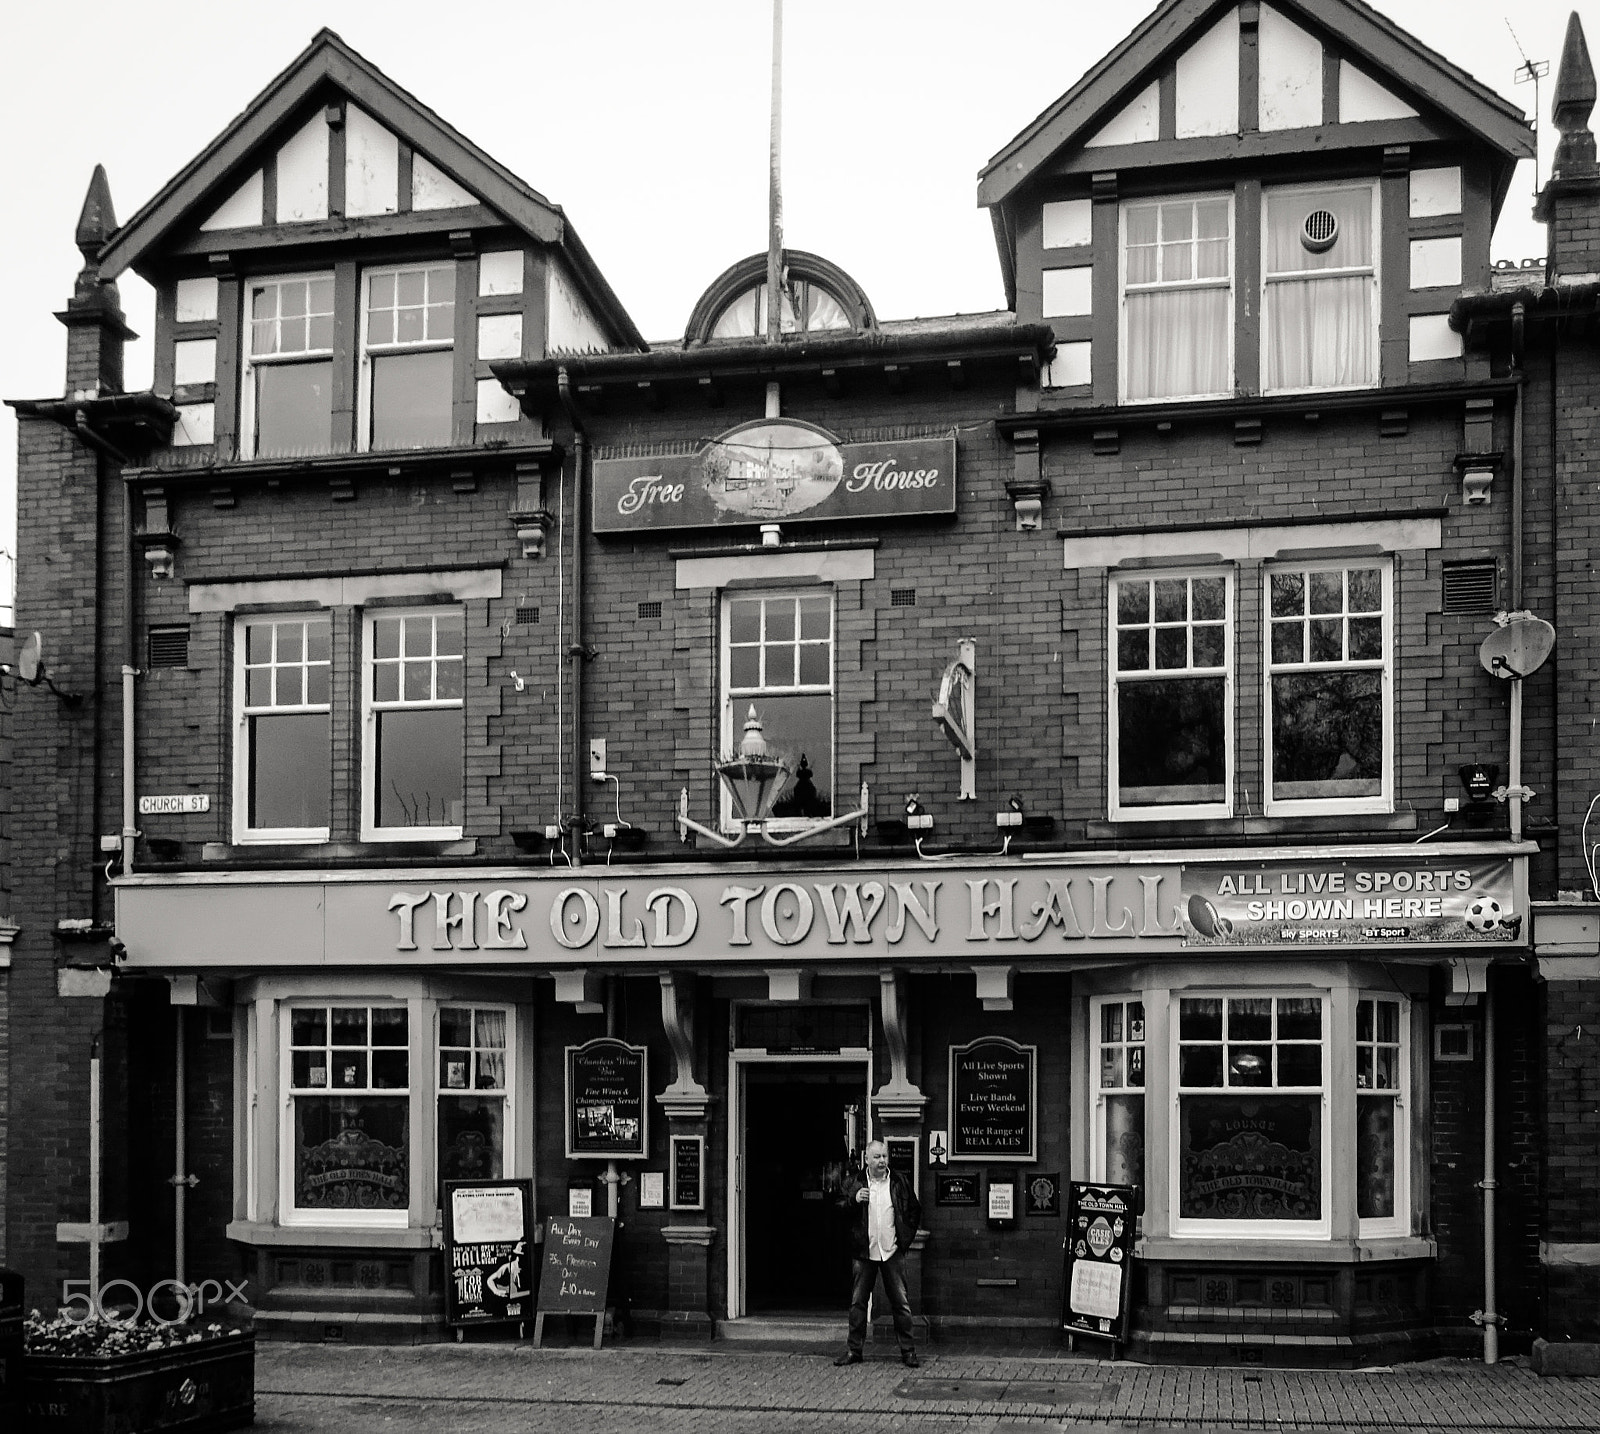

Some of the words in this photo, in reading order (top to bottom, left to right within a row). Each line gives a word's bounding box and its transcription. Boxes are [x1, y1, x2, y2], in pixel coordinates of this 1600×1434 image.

[617, 475, 684, 514] Free
[846, 459, 938, 493] House
[142, 797, 184, 811] CHURCH
[1217, 874, 1271, 895] ALL
[1280, 872, 1346, 894] LIVE
[1355, 869, 1473, 892] SPORTS
[387, 889, 528, 950] THE
[549, 886, 699, 949] OLD
[719, 882, 944, 945] TOWN
[964, 875, 1187, 942] HALL
[1246, 898, 1353, 921] SHOWN
[1364, 897, 1443, 919] HERE
[1299, 929, 1339, 938] SPORTS
[1365, 929, 1380, 937] BT
[1380, 928, 1405, 938] Sport
[962, 1062, 975, 1070] All
[977, 1062, 996, 1070] Live
[997, 1061, 1025, 1071] Sports
[978, 1072, 1007, 1080] Shown
[585, 1088, 600, 1096] Fine
[602, 1088, 621, 1096] Wines
[622, 1088, 629, 1096] &
[970, 1093, 989, 1101] Live
[991, 1093, 1016, 1101] Bands
[575, 1097, 615, 1106] Champagnes
[616, 1097, 640, 1105] Served
[960, 1104, 984, 1113] Every
[987, 1103, 1026, 1112] Weekend
[1225, 1119, 1275, 1131] LOUNGE
[962, 1127, 984, 1135] Wide
[987, 1127, 1013, 1136] Range
[1015, 1127, 1025, 1135] of
[965, 1137, 992, 1145] REAL
[995, 1137, 1021, 1145] ALES
[312, 1174, 329, 1185] THE
[330, 1171, 347, 1179] OLD
[1201, 1181, 1220, 1193] THE
[1222, 1177, 1242, 1187] OLD
[1245, 1176, 1272, 1187] TOWN
[1273, 1179, 1297, 1193] HALL
[1090, 1236, 1110, 1246] ALES
[453, 1250, 481, 1267] HALL
[464, 1275, 482, 1286] FOR
[464, 1284, 482, 1294] LIVE
